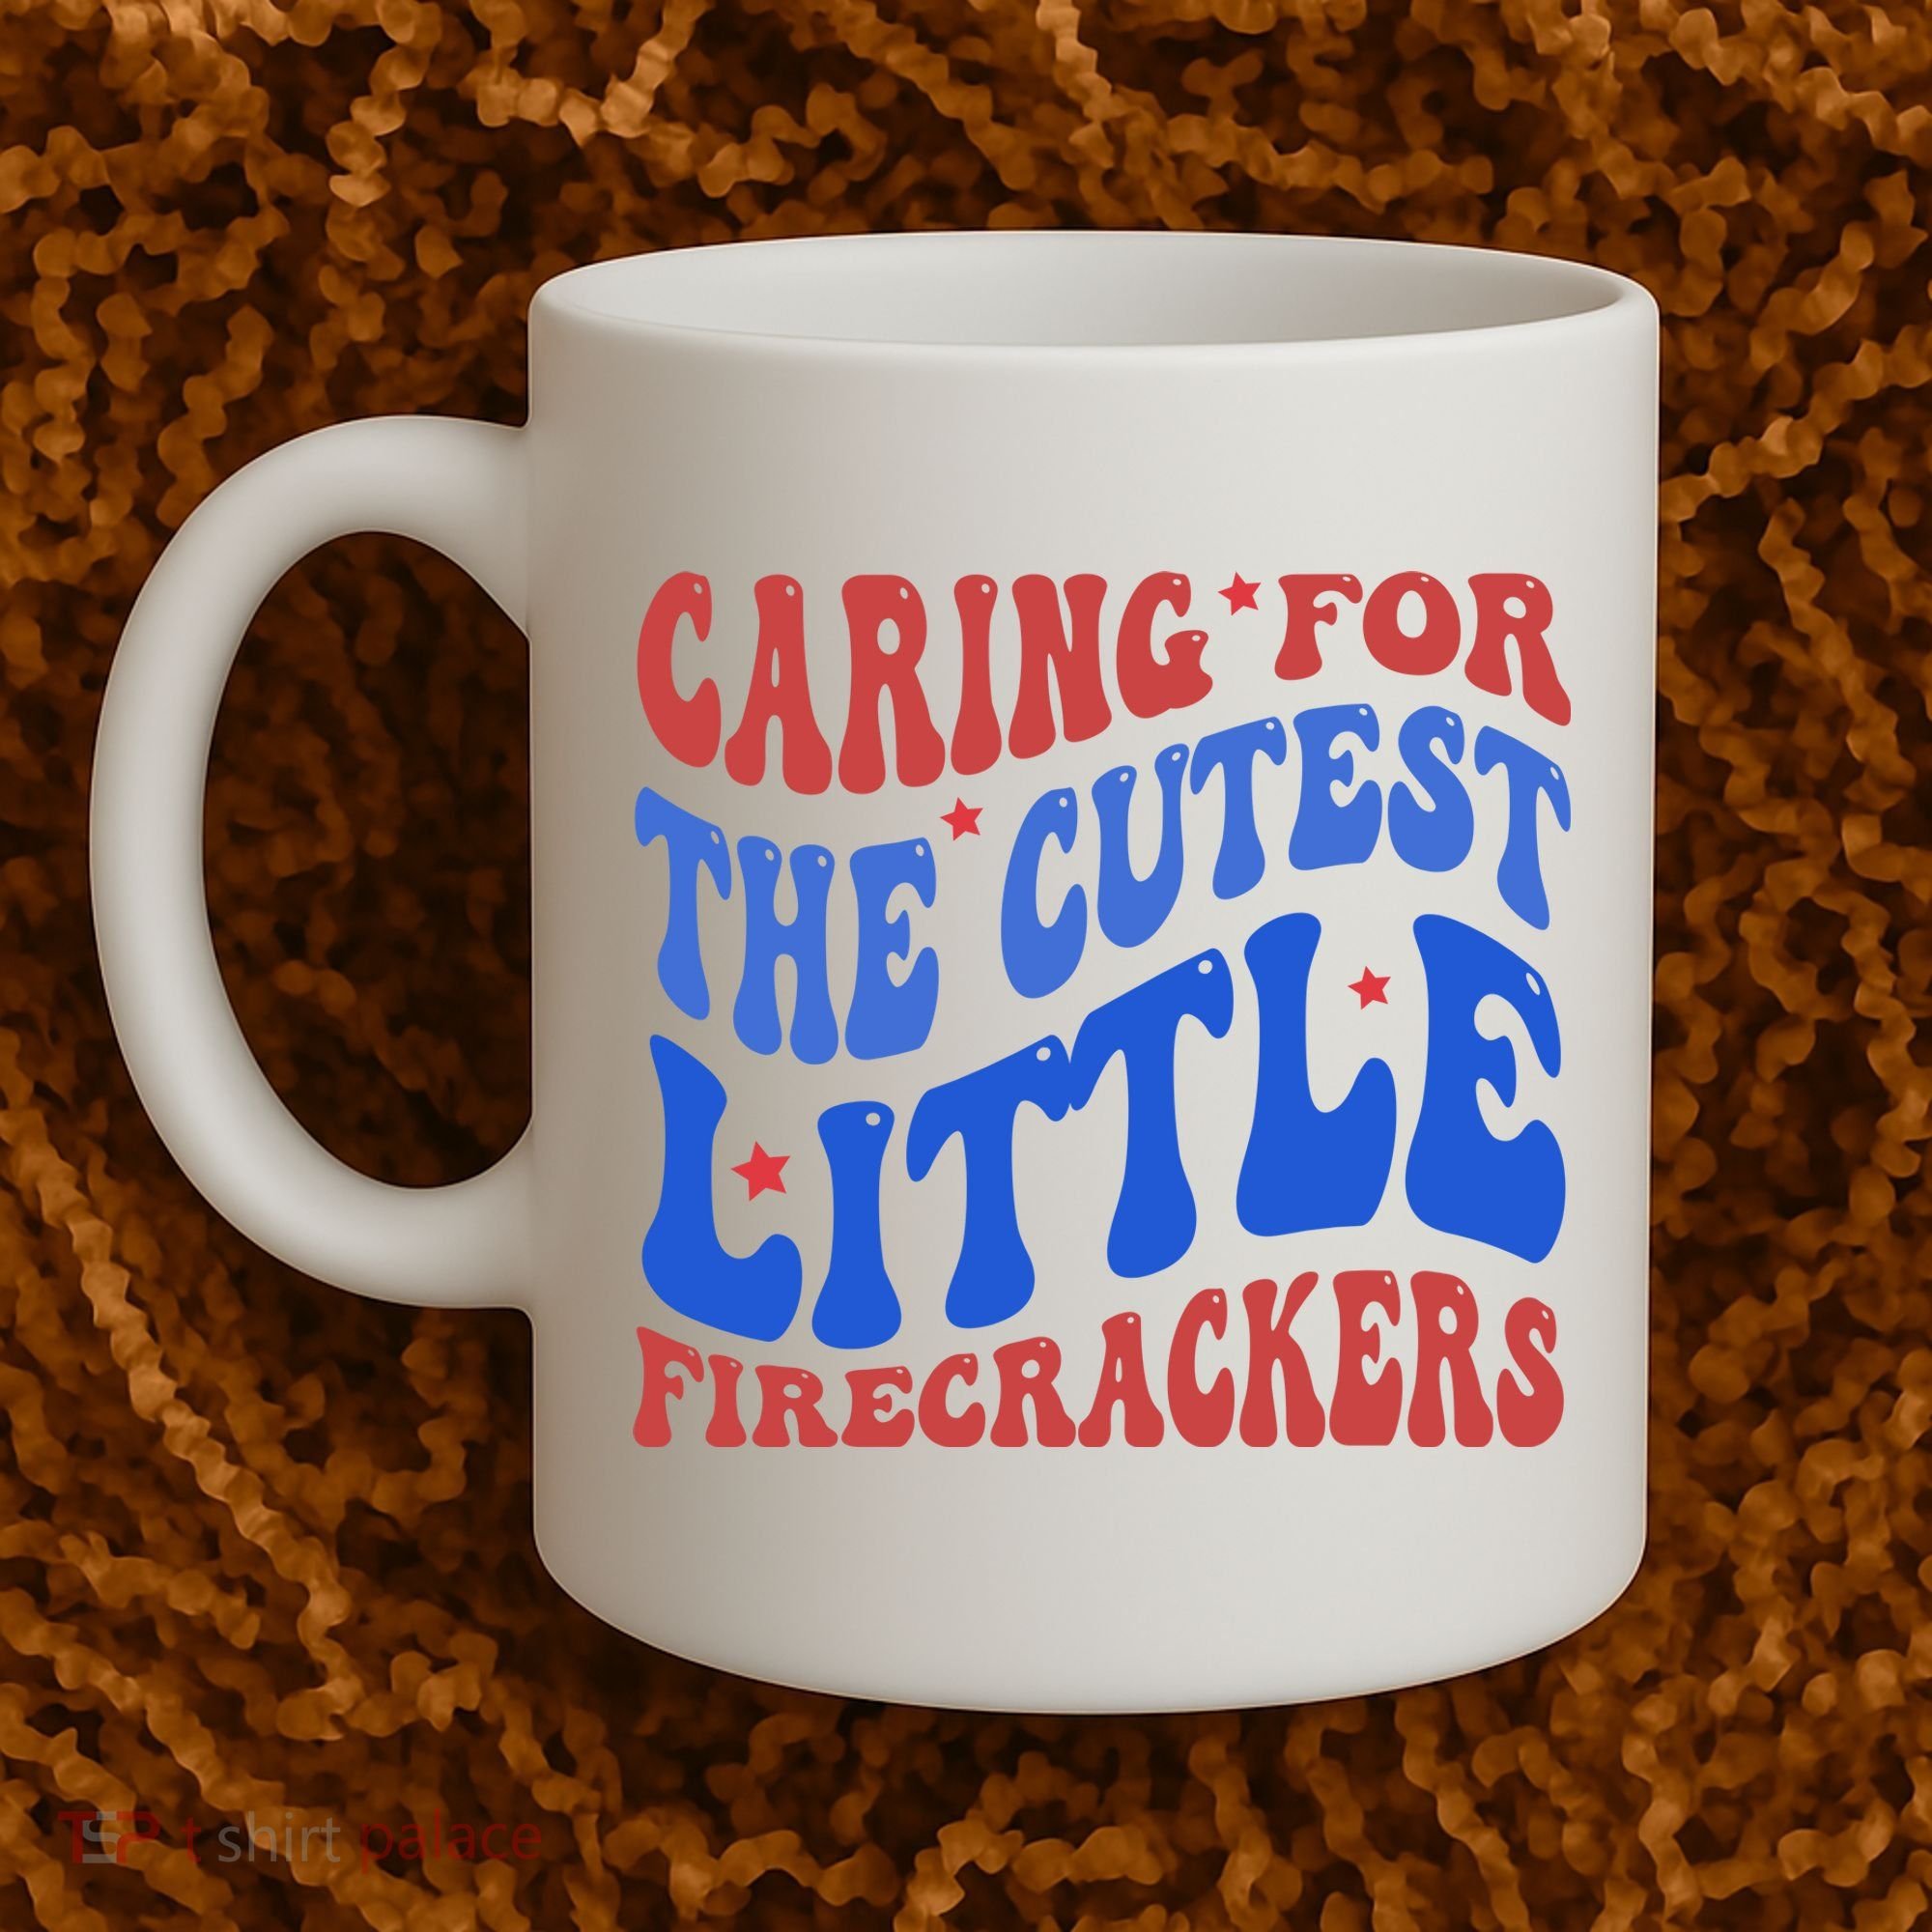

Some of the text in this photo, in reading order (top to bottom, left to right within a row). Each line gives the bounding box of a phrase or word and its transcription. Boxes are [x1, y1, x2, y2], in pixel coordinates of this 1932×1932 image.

[637, 572, 1571, 795] CARING FOR
[636, 704, 1571, 1065] THE CUTEST
[642, 913, 1566, 1350] LITTLE
[633, 1270, 1564, 1447] FIRECRACKERS
